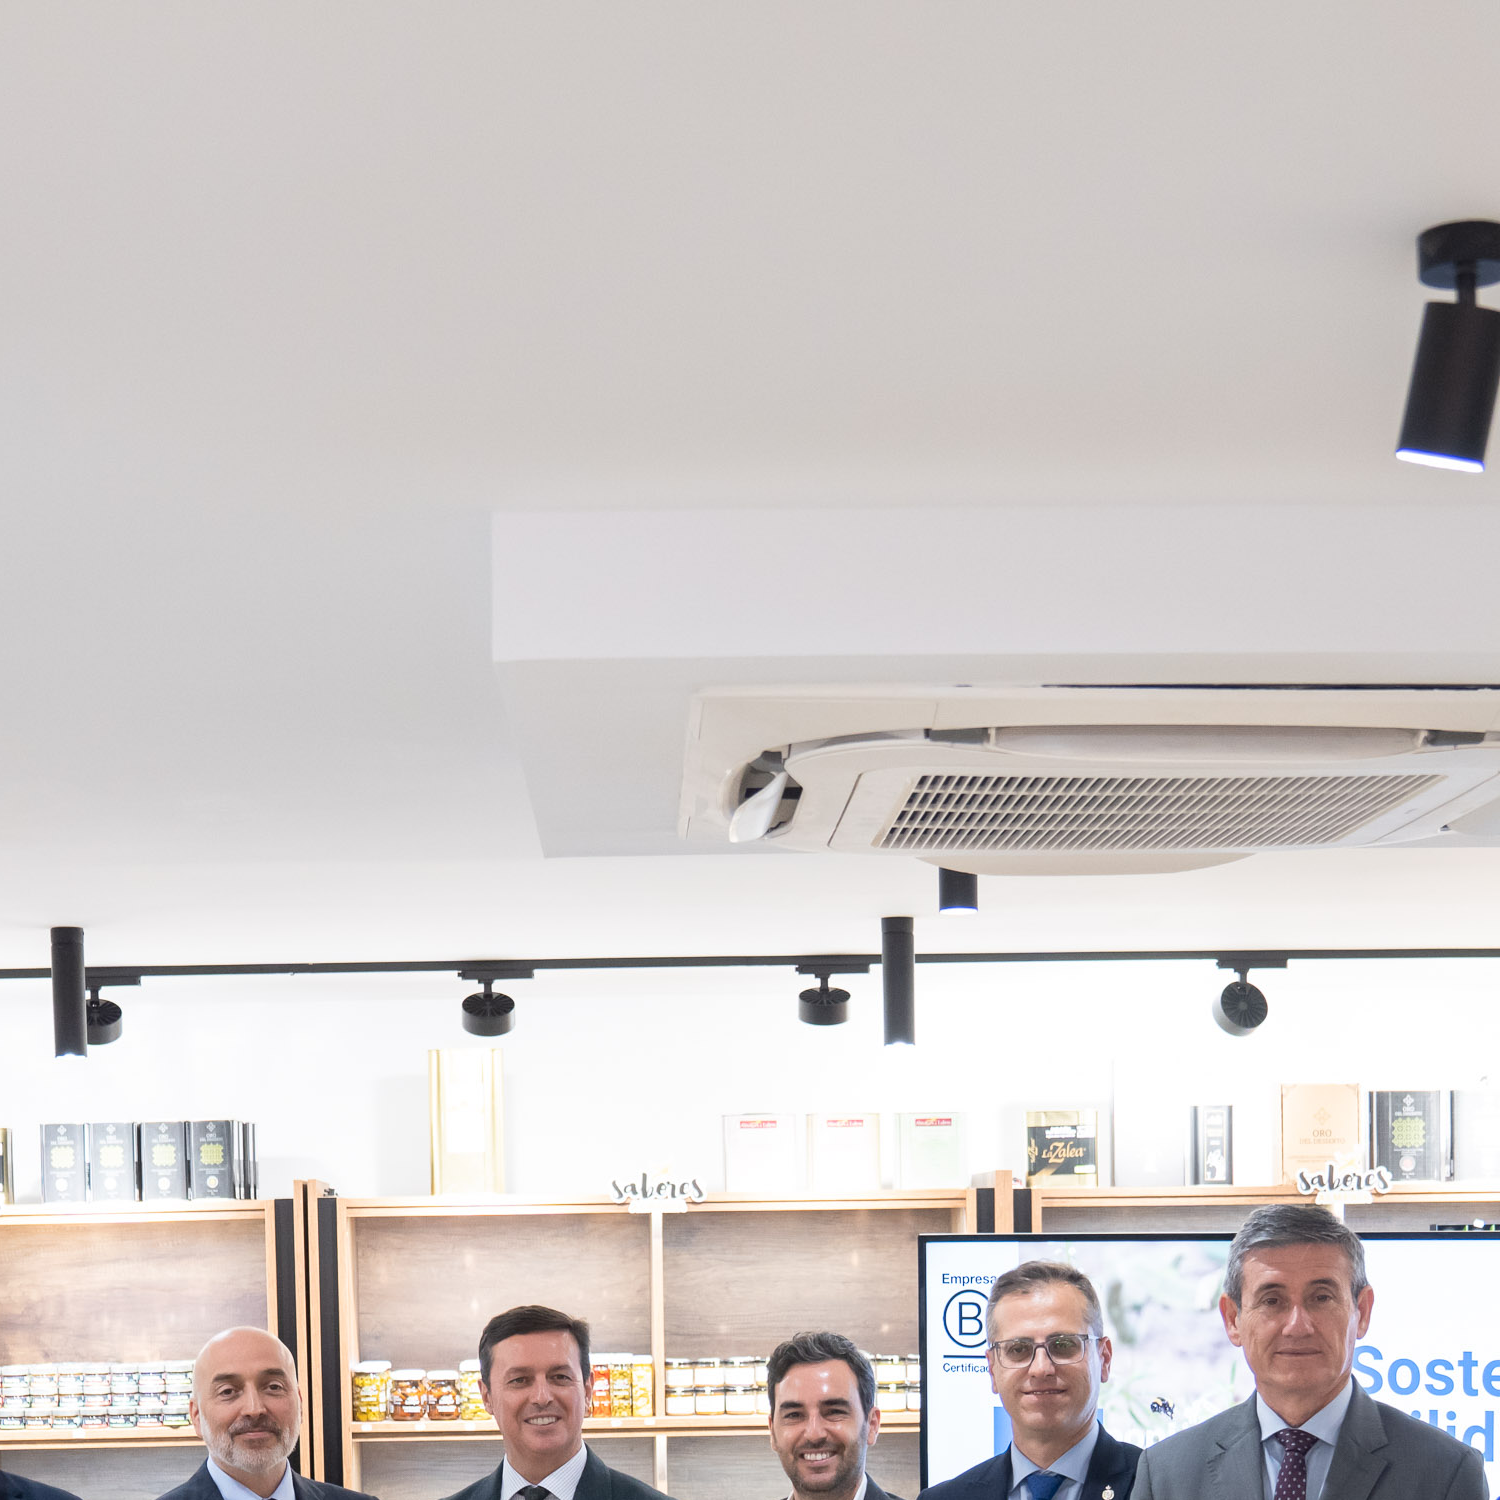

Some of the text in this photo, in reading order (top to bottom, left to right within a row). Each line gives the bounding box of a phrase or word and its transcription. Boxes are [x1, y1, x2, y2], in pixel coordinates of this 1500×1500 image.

[1312, 1129, 1332, 1138] ORO
[942, 1273, 997, 1285] Empresa
[958, 1301, 983, 1336] B
[942, 1363, 988, 1373] Certifica
